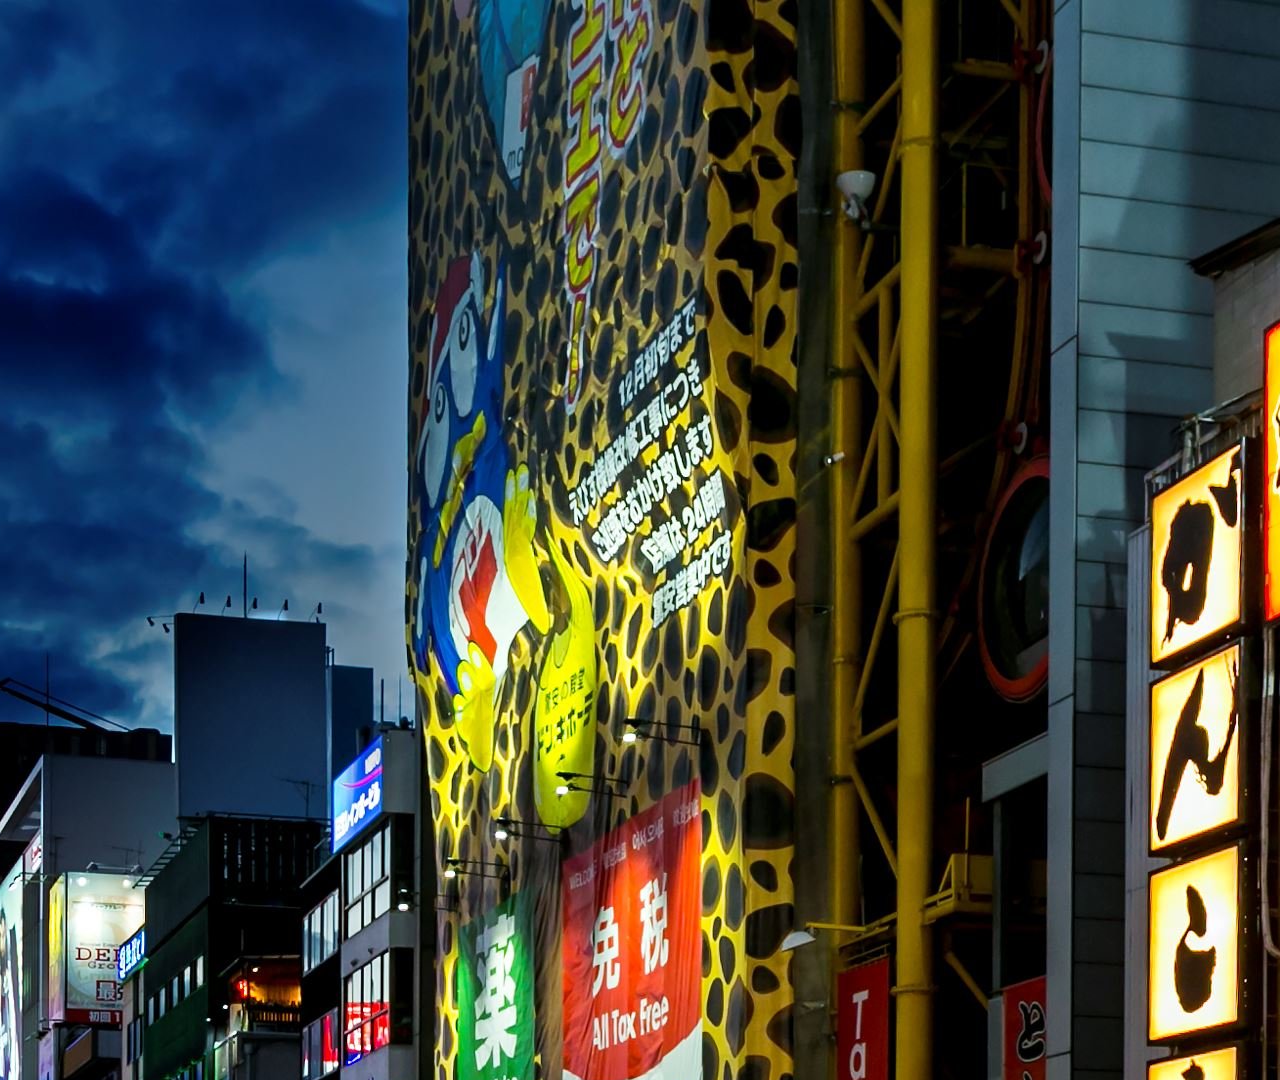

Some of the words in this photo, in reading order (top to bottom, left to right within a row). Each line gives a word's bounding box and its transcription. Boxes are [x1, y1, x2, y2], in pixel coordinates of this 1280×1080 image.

[475, 912, 517, 1071] 薬
[592, 872, 670, 999] 免税
[593, 1015, 610, 1051] All
[611, 1009, 637, 1044] Tax
[640, 997, 669, 1036] Free
